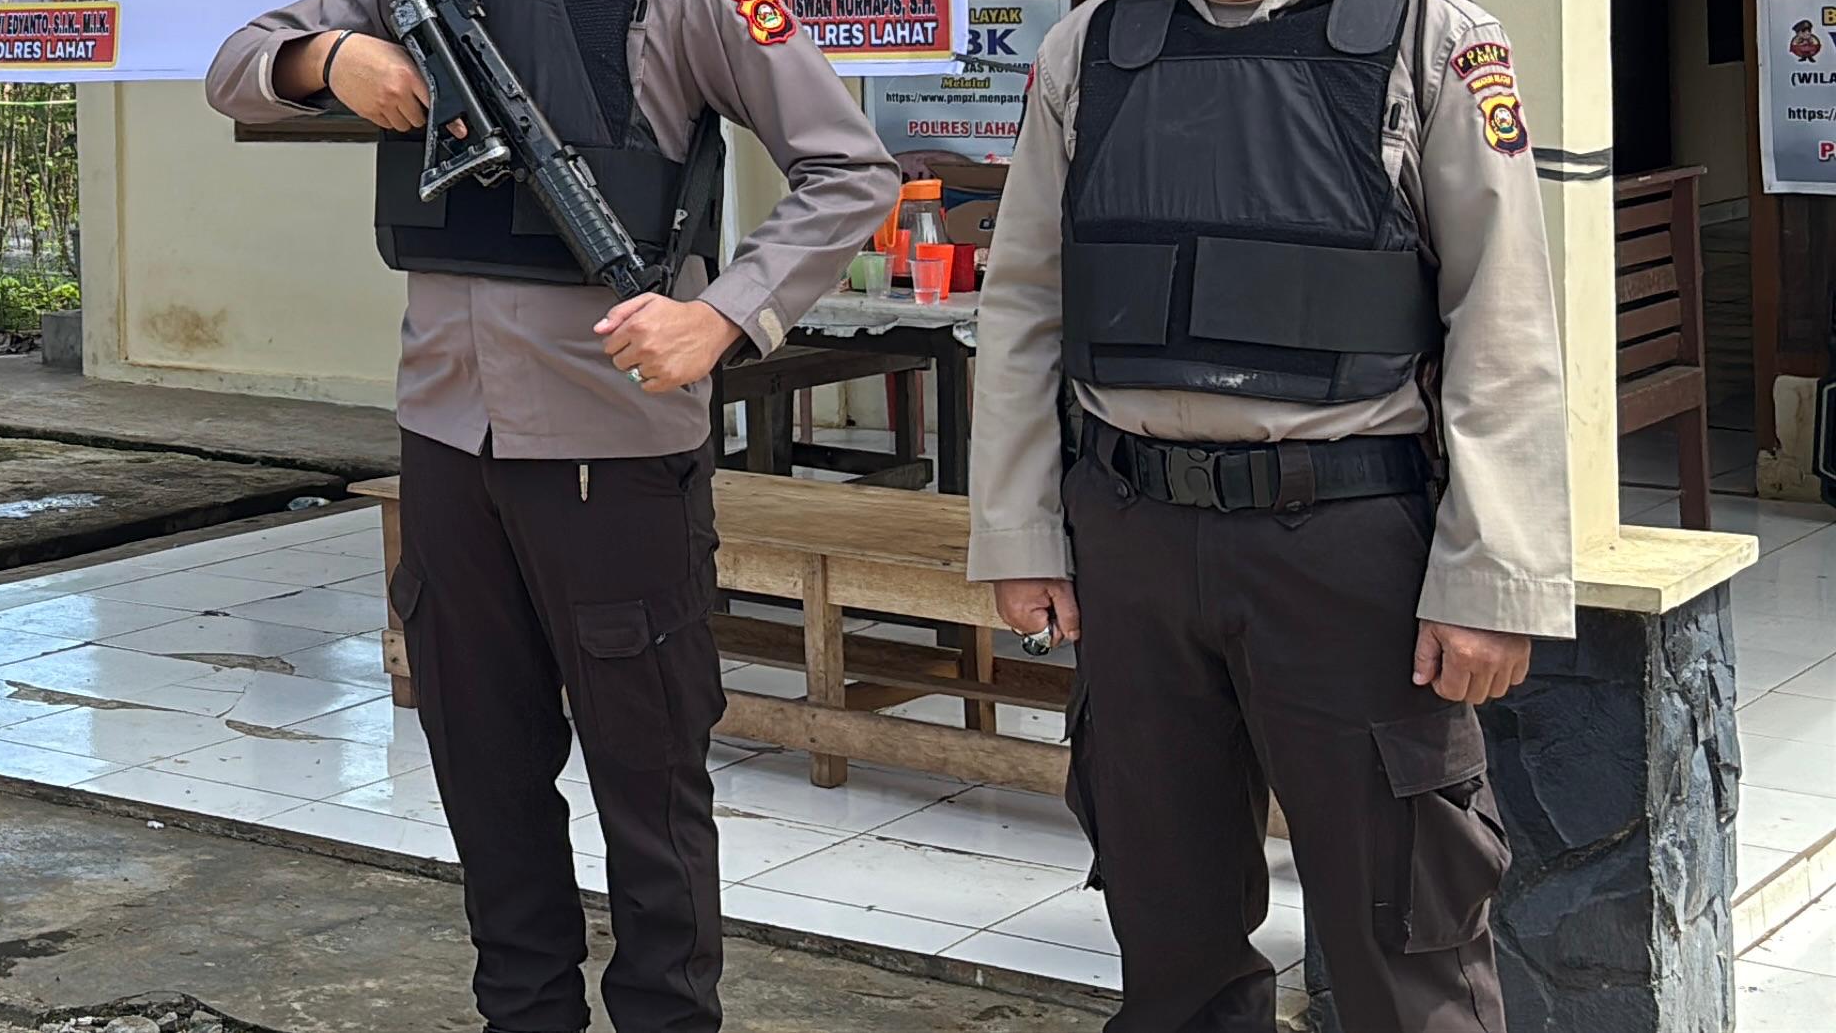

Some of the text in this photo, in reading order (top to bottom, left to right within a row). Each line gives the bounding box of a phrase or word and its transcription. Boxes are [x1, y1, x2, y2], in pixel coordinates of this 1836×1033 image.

[970, 7, 1022, 24] LAYAK
[870, 22, 938, 46] LAHAT
[966, 28, 1018, 56] BK
[46, 40, 96, 59] LAHAT
[940, 76, 991, 90] Melalui
[1790, 72, 1836, 87] (WILA
[886, 92, 1026, 105] https://www.pmpzi.menpan.
[909, 120, 1019, 137] POLRES LAHA
